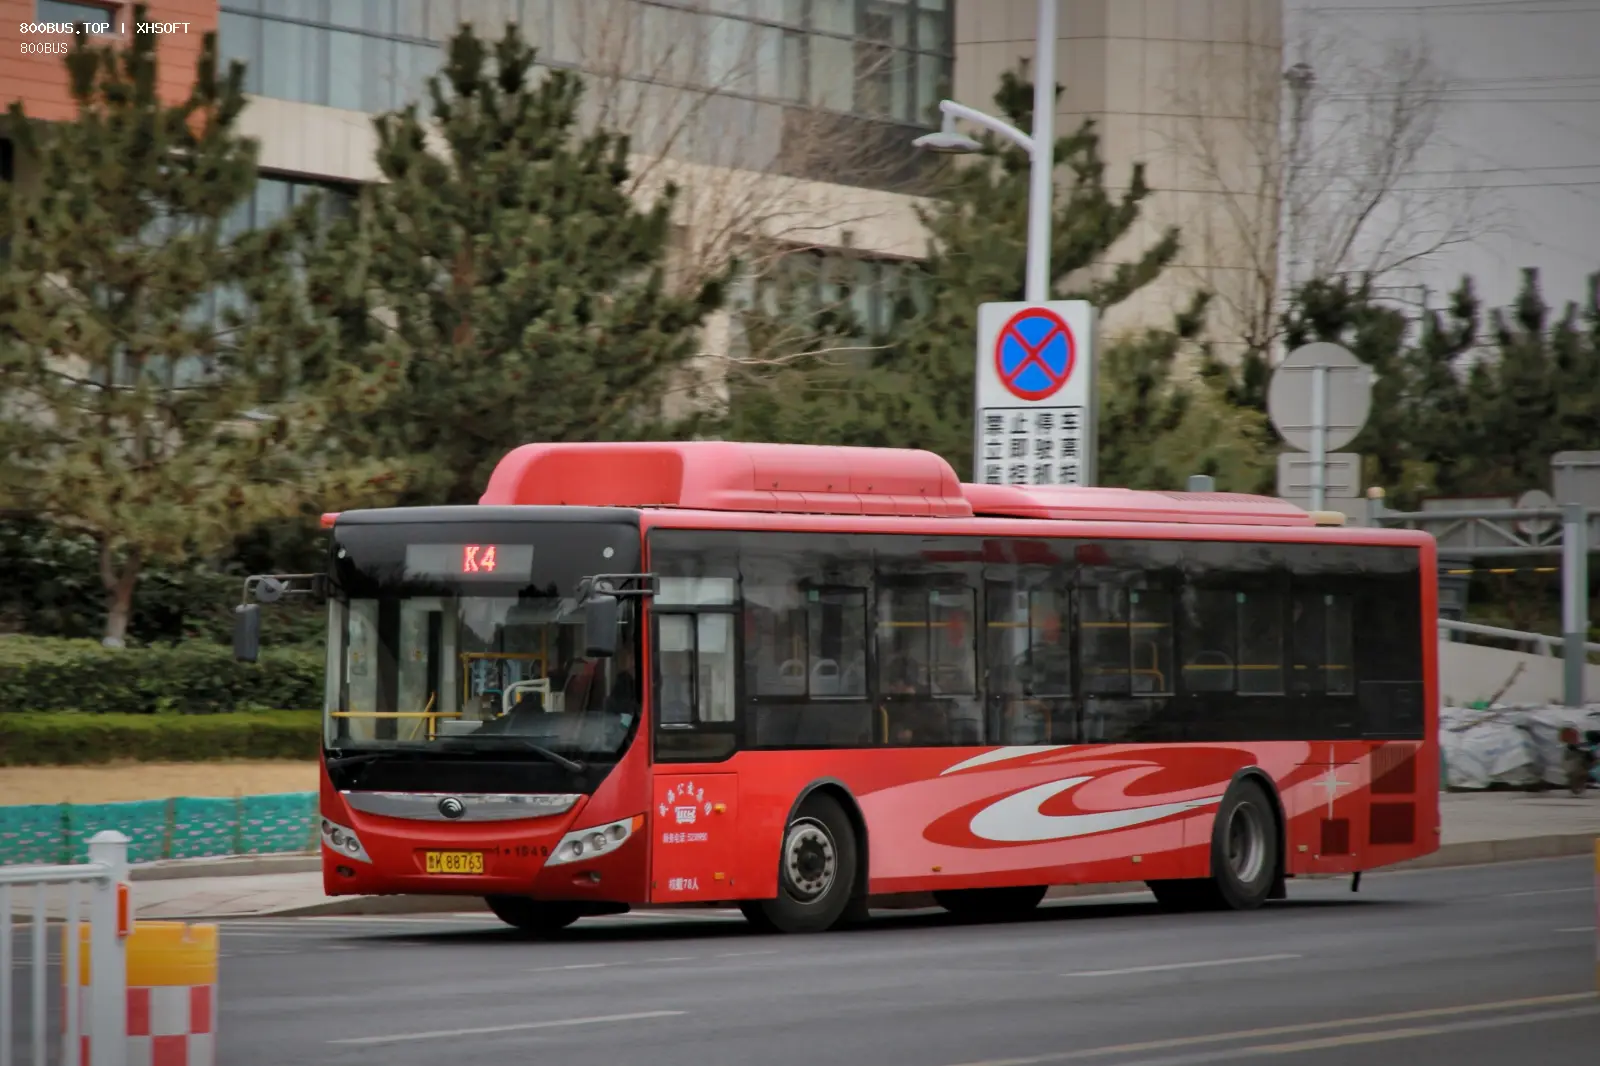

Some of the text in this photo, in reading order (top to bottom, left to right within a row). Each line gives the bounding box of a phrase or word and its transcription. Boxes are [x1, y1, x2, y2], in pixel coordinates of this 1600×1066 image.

[984, 412, 1079, 435] 禁止停车
[984, 437, 1078, 460] 立即驶离
[463, 544, 496, 573] K4
